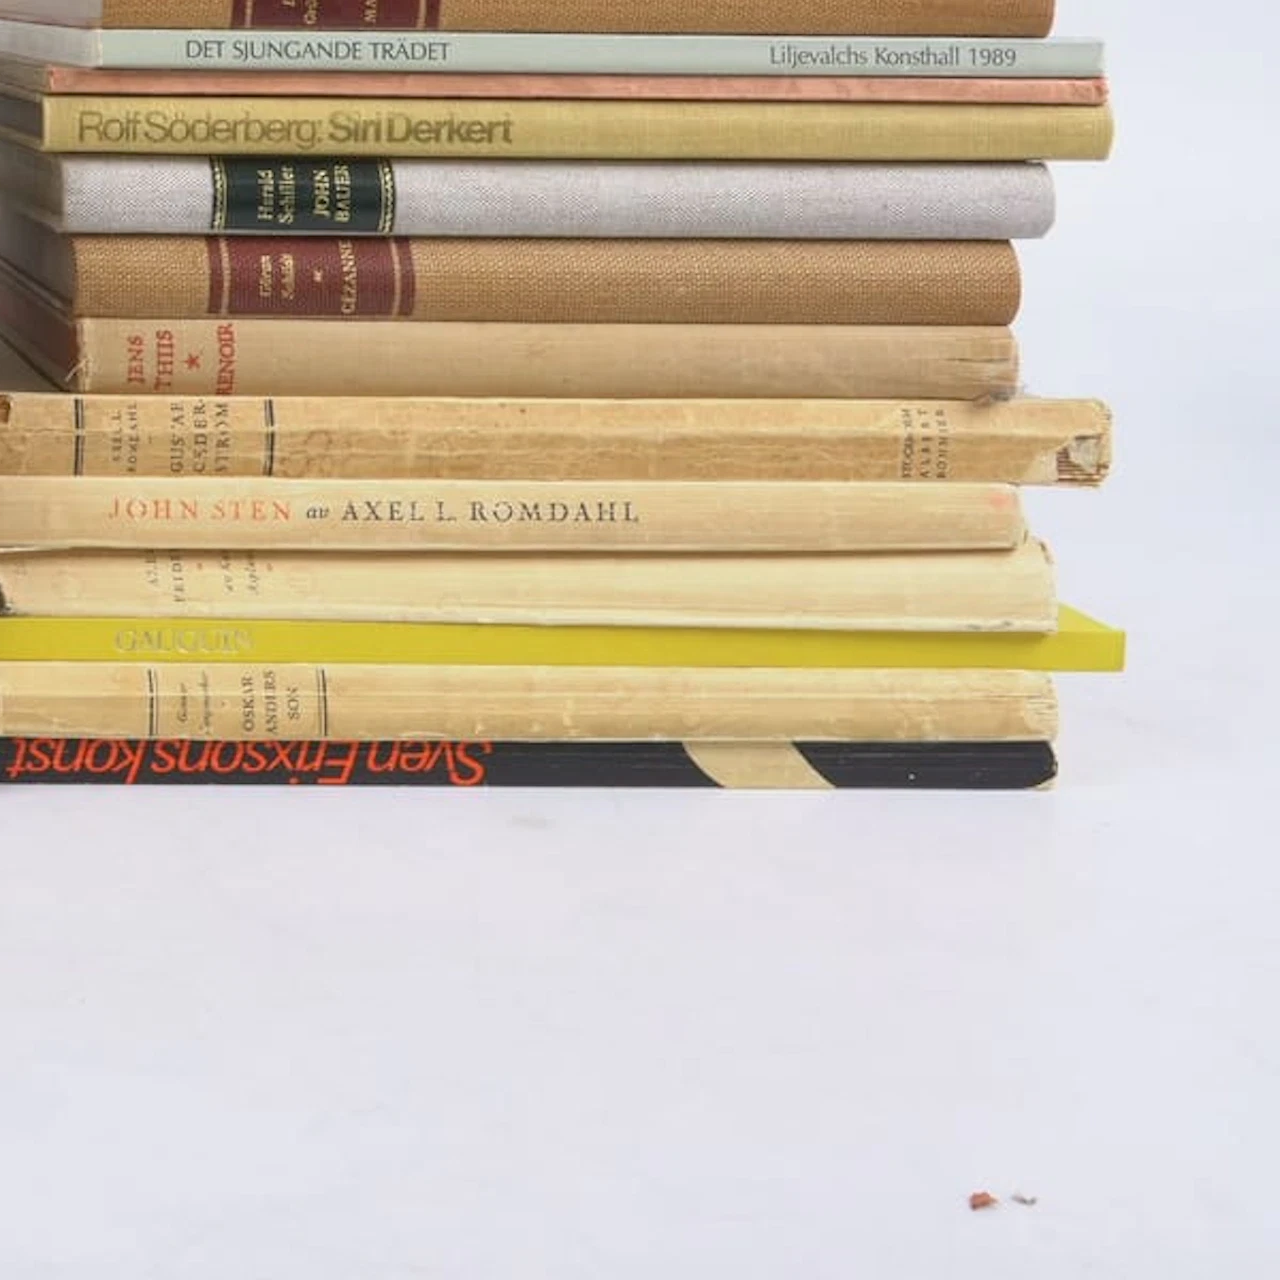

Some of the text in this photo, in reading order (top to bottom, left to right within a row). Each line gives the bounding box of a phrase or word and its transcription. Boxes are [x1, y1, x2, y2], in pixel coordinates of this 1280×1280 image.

[185, 37, 451, 61] DET SJUNGANDE TRÄDET
[769, 45, 1017, 69] Liljevalchs Konsthall 1989
[78, 109, 513, 149] Rolf Söderberg: Siri Derkert
[257, 168, 275, 221] Harald
[312, 169, 331, 218] JOHN
[334, 164, 352, 223] BAUER
[126, 334, 146, 385] JENS
[153, 329, 175, 392] THIIS
[214, 322, 237, 396] RENOIR
[107, 497, 198, 521] JOHN
[212, 499, 290, 521] STEN
[306, 504, 330, 520] av
[341, 500, 426, 522] AXEL
[469, 500, 640, 523] ROMDAHL
[115, 628, 254, 654] GAUGUIN
[242, 674, 255, 733] OSKAR
[5, 738, 141, 785] konst
[366, 739, 495, 786] Sven
